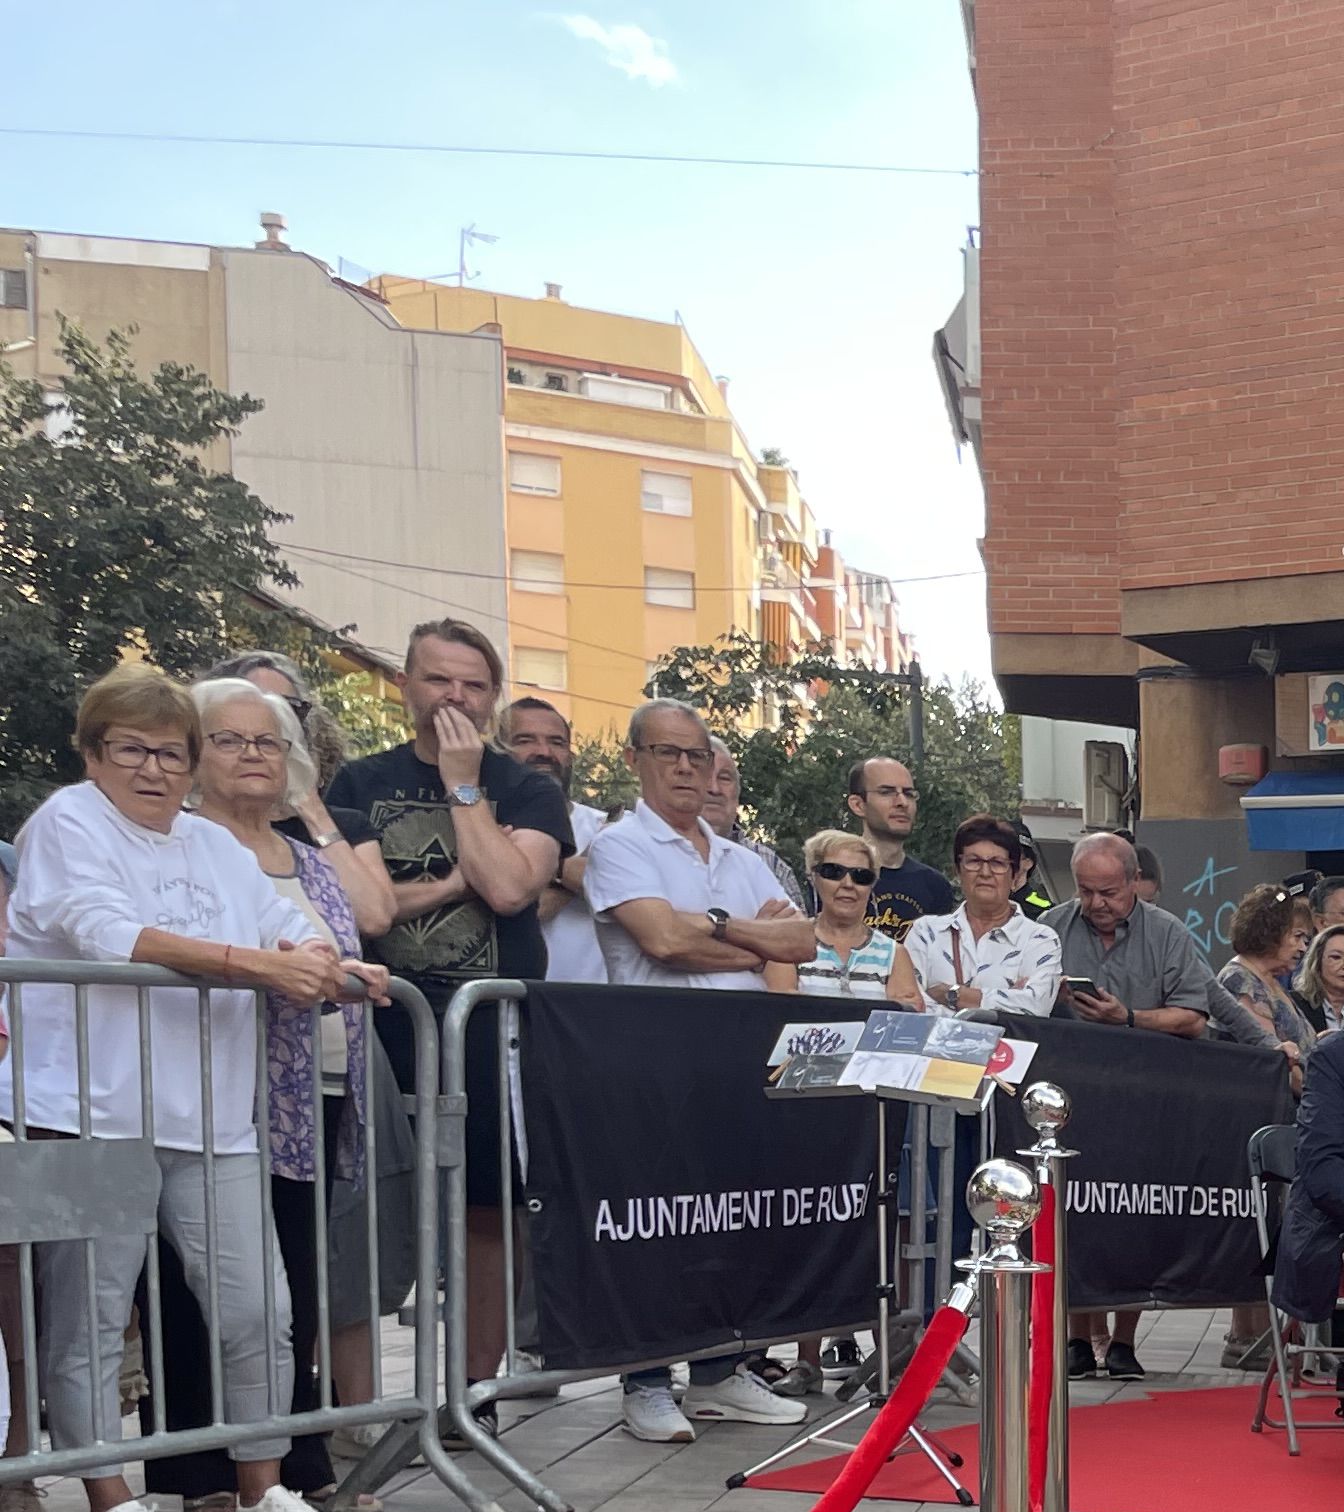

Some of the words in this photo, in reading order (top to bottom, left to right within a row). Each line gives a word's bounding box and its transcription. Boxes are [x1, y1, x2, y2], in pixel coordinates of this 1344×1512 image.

[595, 1189, 775, 1242] AJUNTAMENT
[782, 1187, 814, 1226] DE
[816, 1172, 873, 1222] RUBÍ
[1065, 1180, 1189, 1216] JUNTAMENT
[1190, 1186, 1219, 1217] DE
